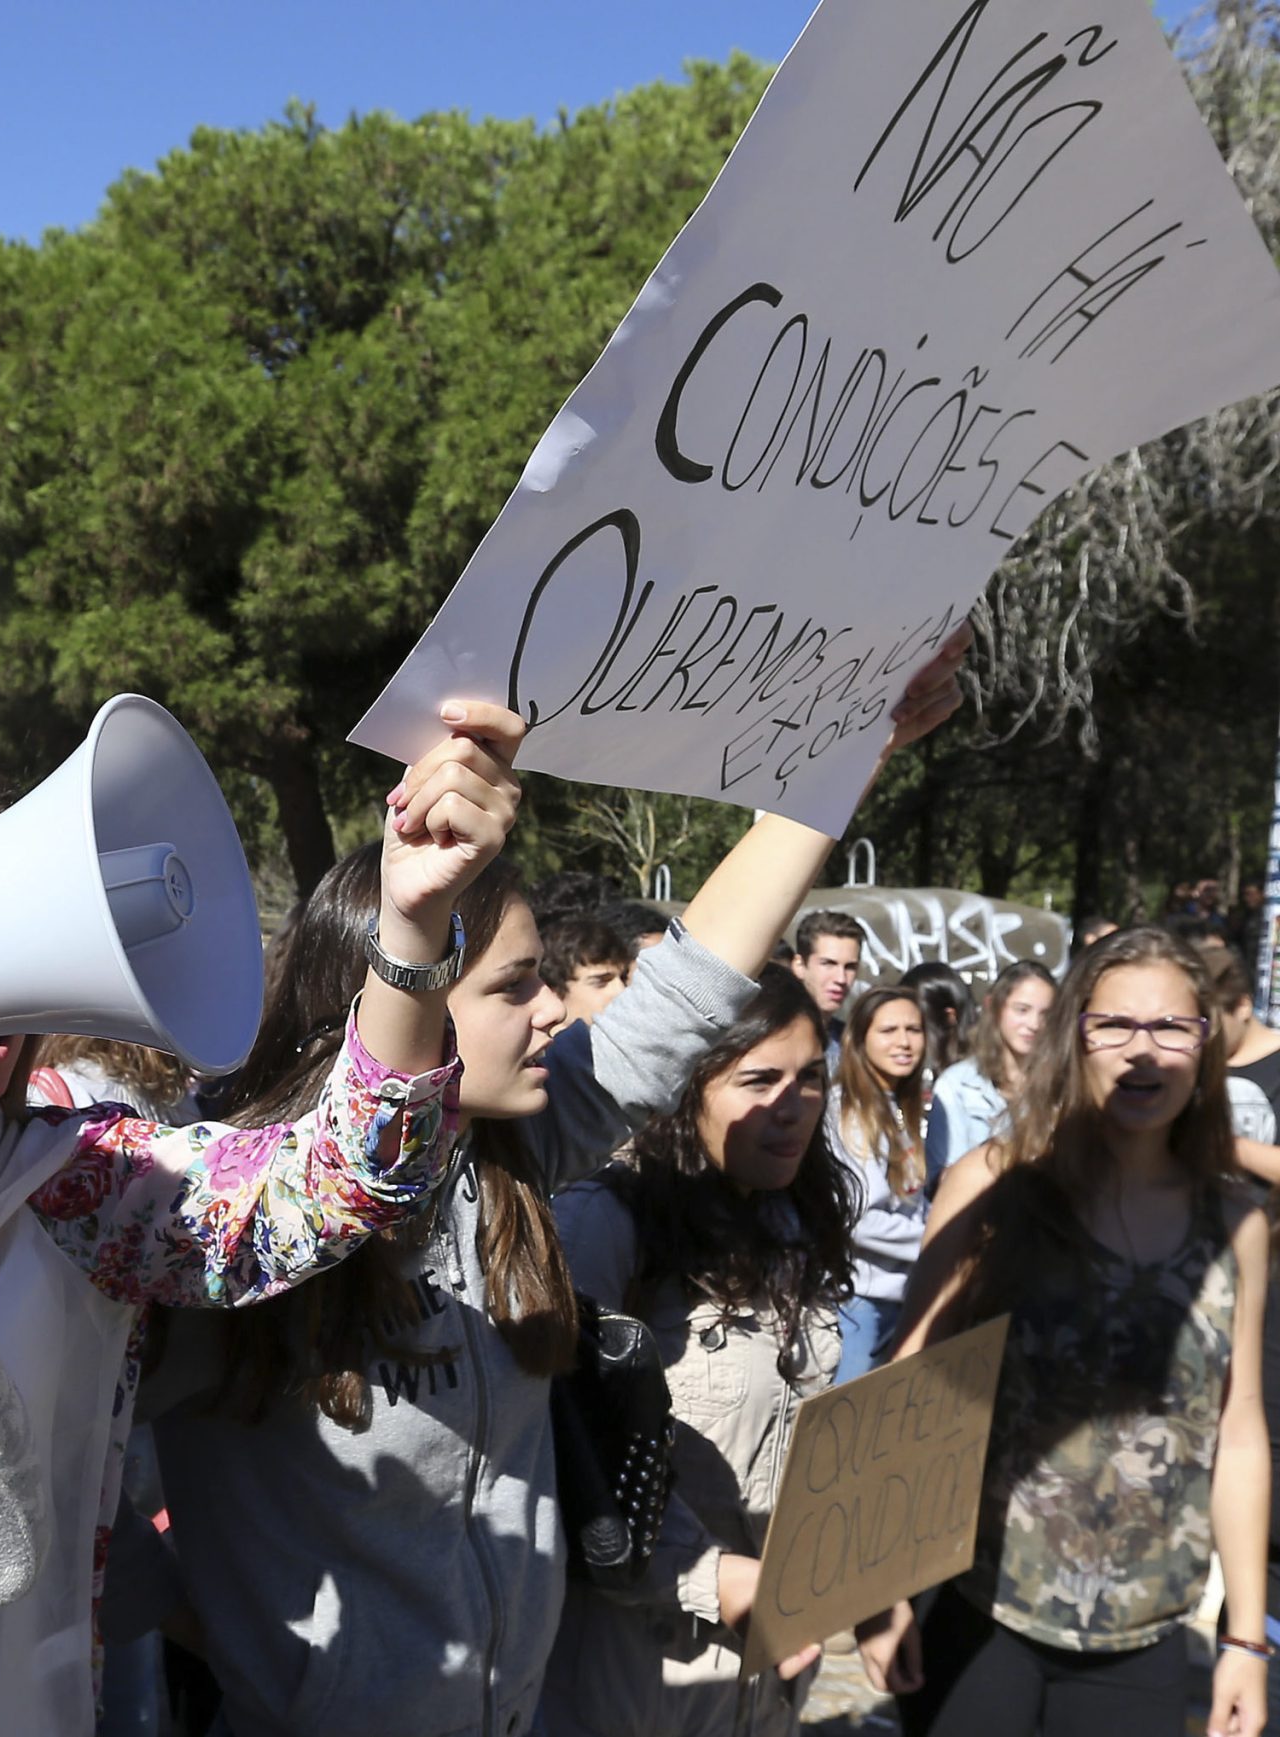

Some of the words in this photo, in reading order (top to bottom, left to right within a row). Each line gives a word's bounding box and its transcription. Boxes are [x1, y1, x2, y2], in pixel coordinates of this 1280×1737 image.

[854, 0, 1118, 264] NÃO
[1005, 199, 1208, 365] HÁ
[655, 281, 1037, 542] CONDIÇÕES
[989, 440, 1089, 541] E
[507, 508, 853, 734] QUEREMOS
